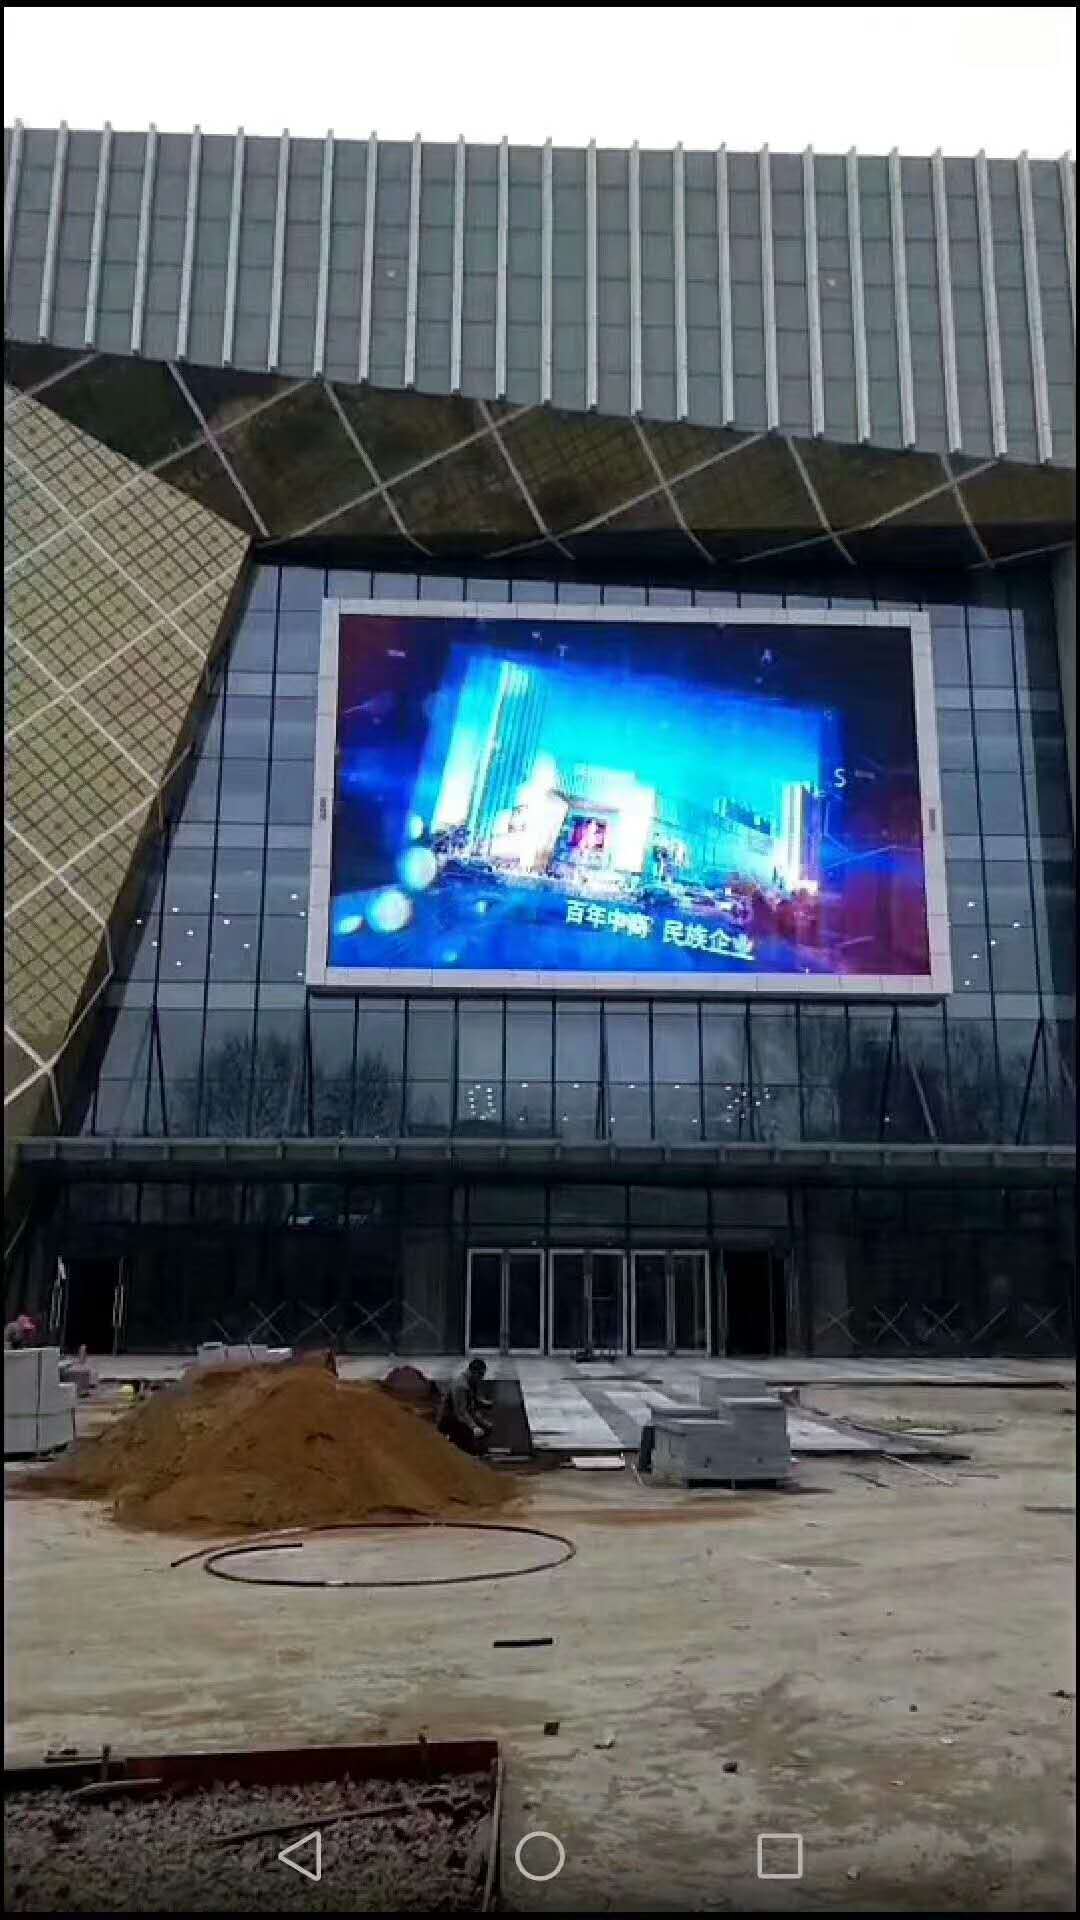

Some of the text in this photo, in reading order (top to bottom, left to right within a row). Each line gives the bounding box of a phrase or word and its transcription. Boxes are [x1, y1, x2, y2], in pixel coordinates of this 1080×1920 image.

[834, 768, 847, 788] S
[663, 919, 755, 960] 民族企业
